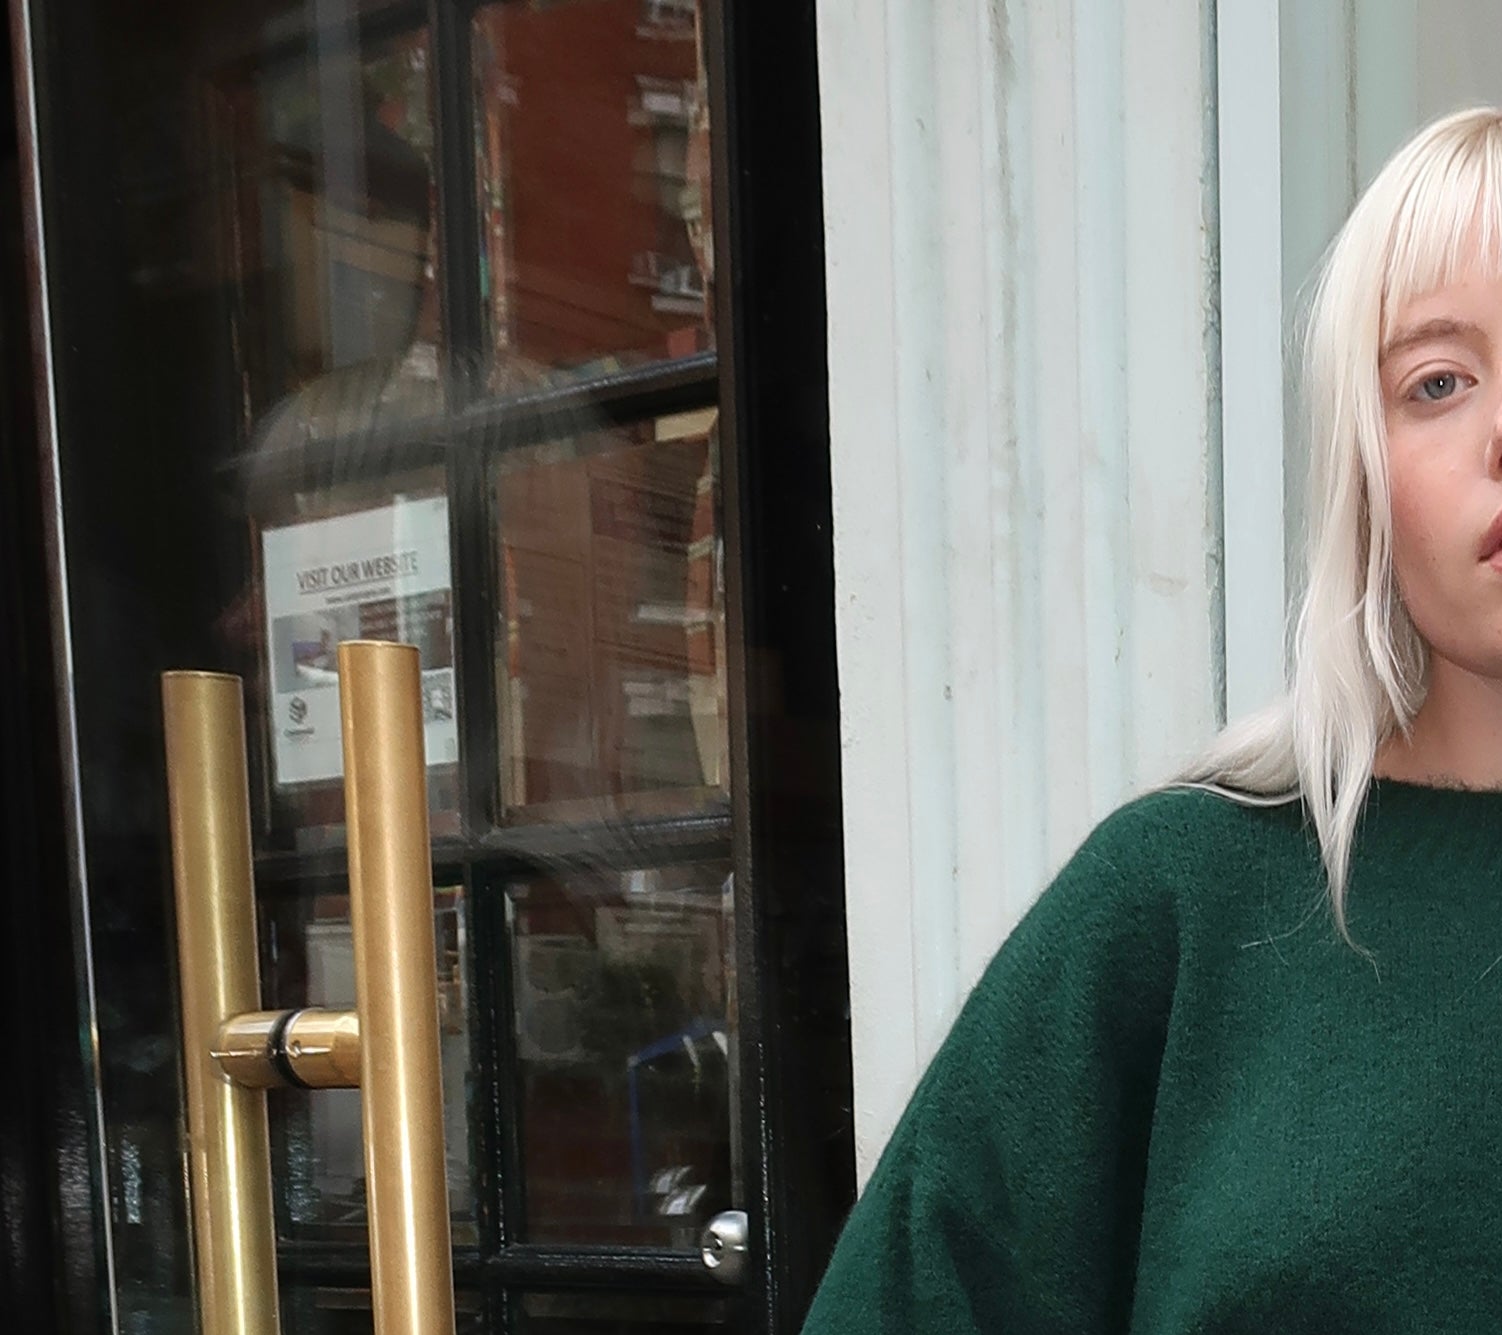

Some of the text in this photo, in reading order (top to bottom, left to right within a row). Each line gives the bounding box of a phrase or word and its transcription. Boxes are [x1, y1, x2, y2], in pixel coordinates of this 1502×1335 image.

[296, 549, 418, 590] VISIT OUR WEBSTE
